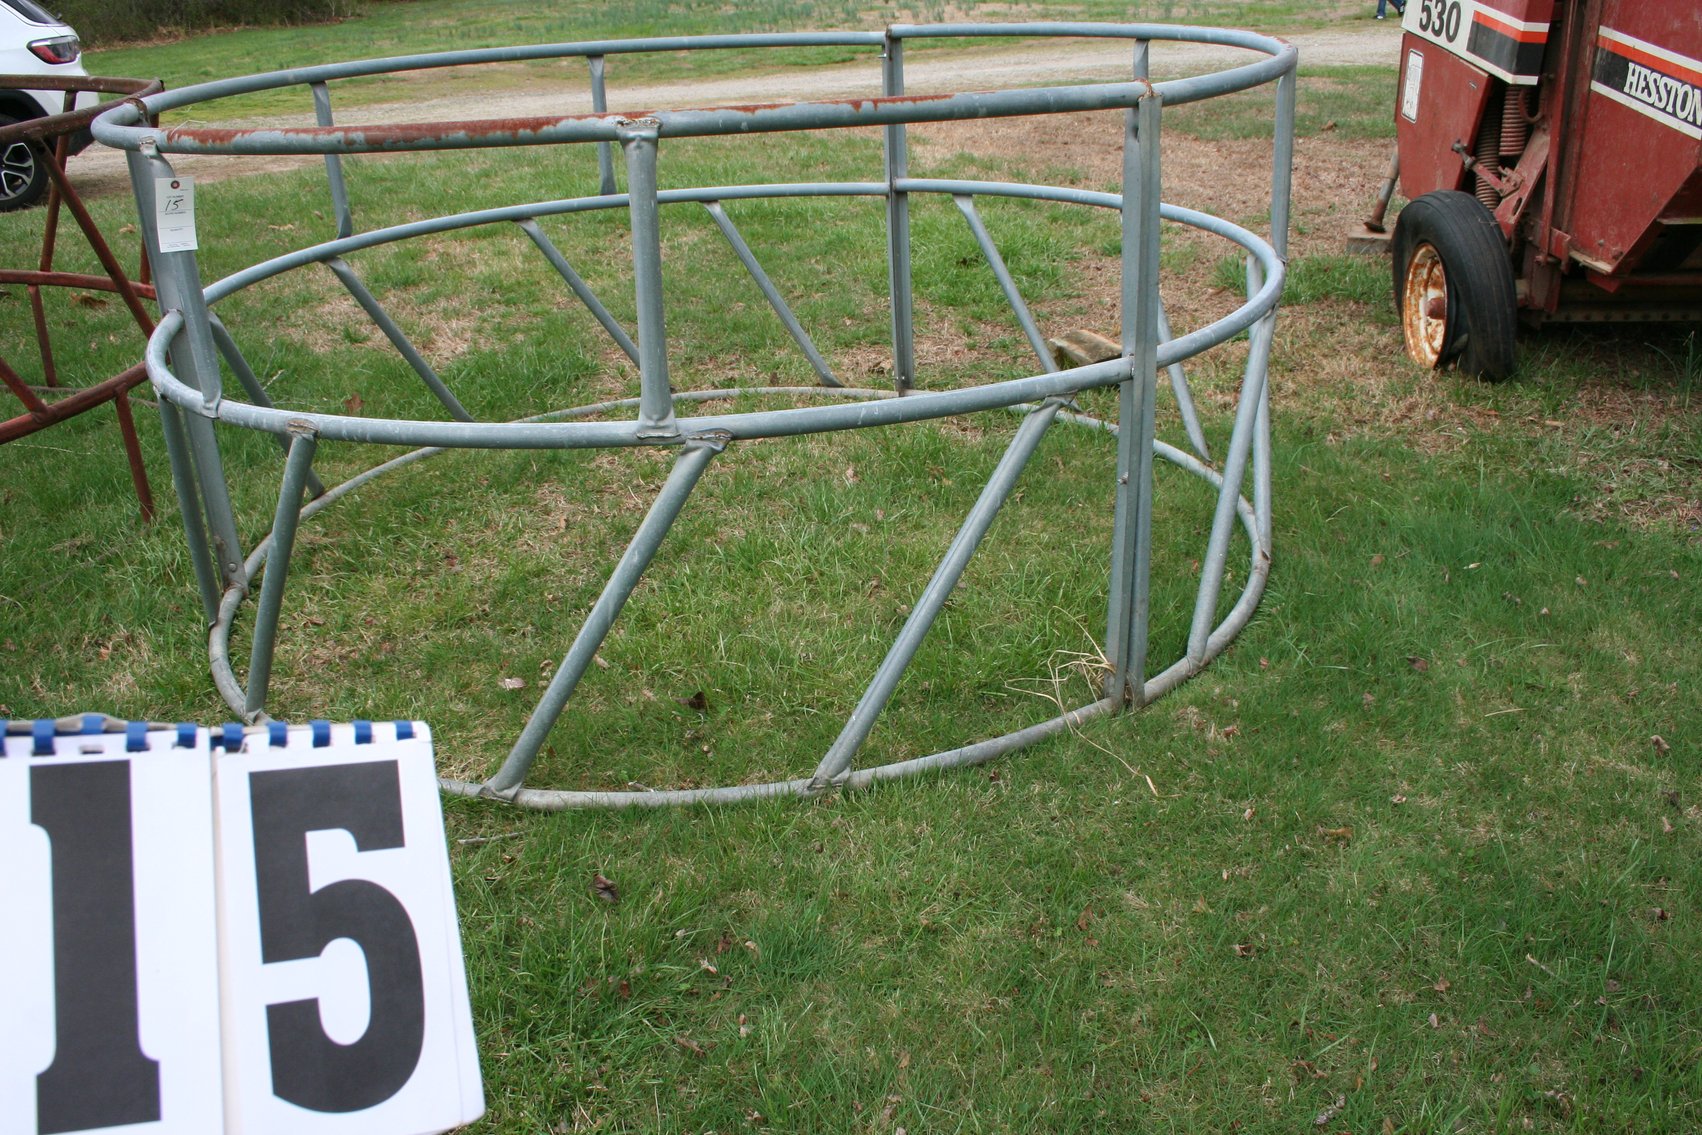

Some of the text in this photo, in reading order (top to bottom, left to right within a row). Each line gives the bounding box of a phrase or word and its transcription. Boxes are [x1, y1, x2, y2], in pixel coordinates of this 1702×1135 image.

[1419, 0, 1462, 43] 530
[1623, 61, 1702, 126] HESSTON
[165, 198, 184, 212] 15
[29, 759, 426, 1135] 15
